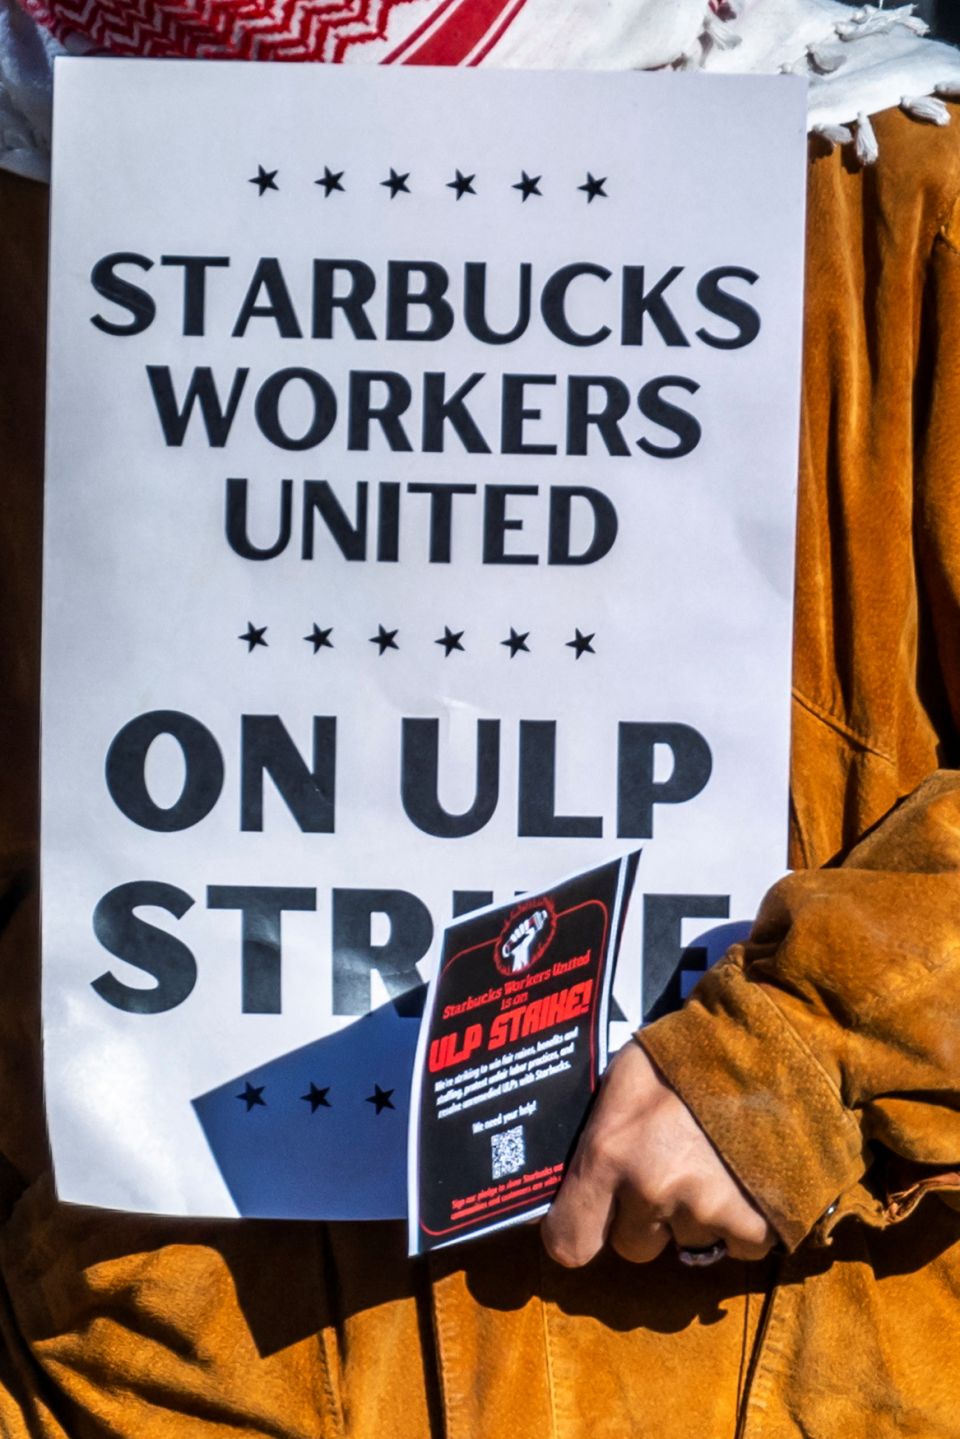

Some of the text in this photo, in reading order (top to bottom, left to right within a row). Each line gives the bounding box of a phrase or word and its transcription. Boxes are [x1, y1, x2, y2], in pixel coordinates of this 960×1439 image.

[88, 250, 762, 351] STARBUCKS
[146, 364, 703, 460] WORKERS
[224, 478, 620, 567] UNITED
[104, 709, 714, 840] ON ULP
[89, 880, 731, 1028] STRE
[442, 948, 592, 1021] Starbucks Workers United
[428, 978, 594, 1073] ULP STRIKE!
[512, 992, 529, 1006] on
[434, 1077, 454, 1092] We're
[454, 1067, 480, 1086] striking
[488, 1058, 502, 1070] win
[501, 1053, 514, 1065] fair
[536, 1034, 564, 1052] benefits
[564, 1025, 579, 1041] and
[463, 1077, 488, 1097] protest
[488, 1069, 509, 1085] unfair
[509, 1062, 528, 1076] labor
[560, 1041, 575, 1056] and
[519, 1072, 536, 1086] with
[535, 1060, 572, 1081] Starbucks.
[472, 1100, 537, 1134] We need your help!
